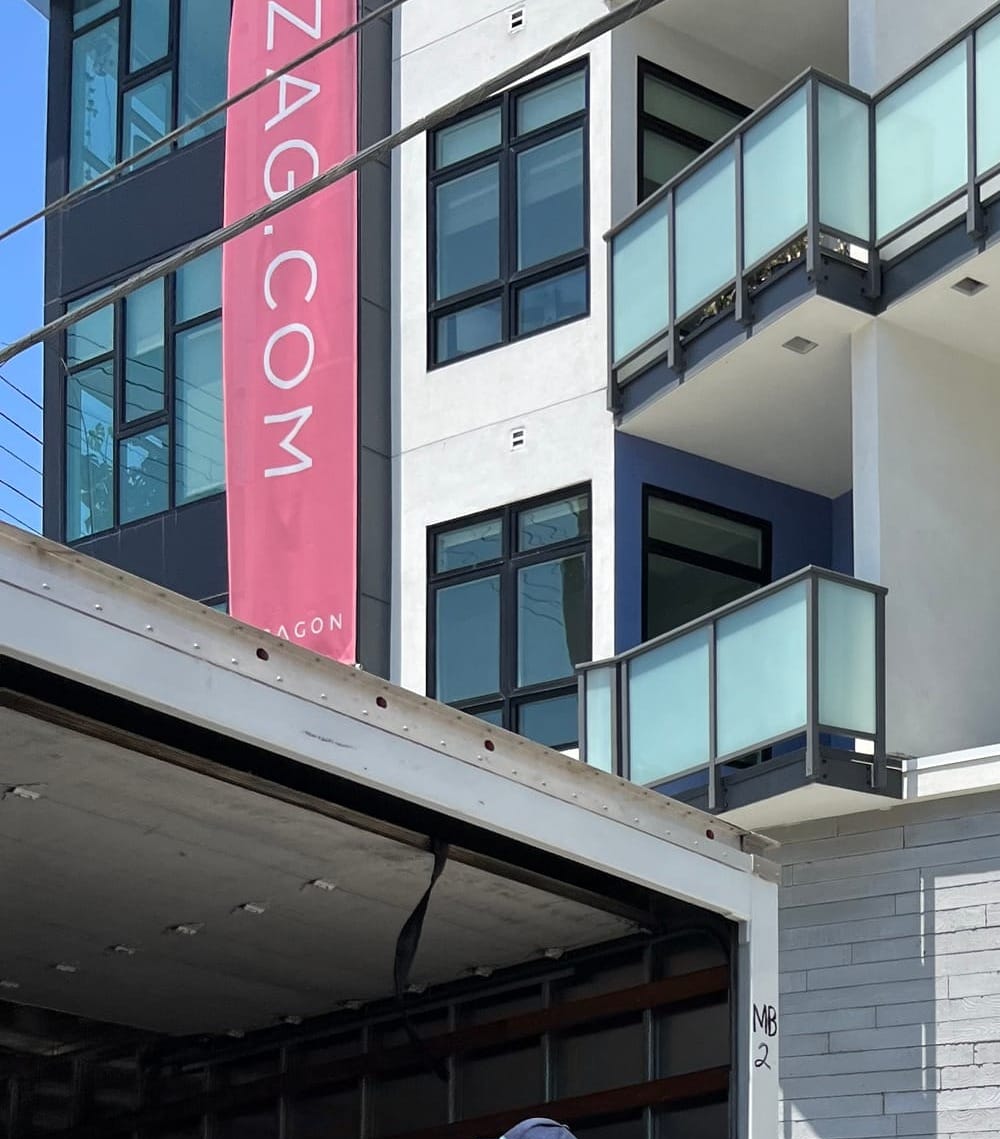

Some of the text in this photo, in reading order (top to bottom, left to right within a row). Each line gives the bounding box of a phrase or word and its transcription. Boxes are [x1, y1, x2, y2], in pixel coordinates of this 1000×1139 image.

[263, 0, 322, 478] ZAG.COM
[263, 613, 342, 641] AGON
[753, 1004, 778, 1037] MB
[755, 1043, 771, 1070] 2
